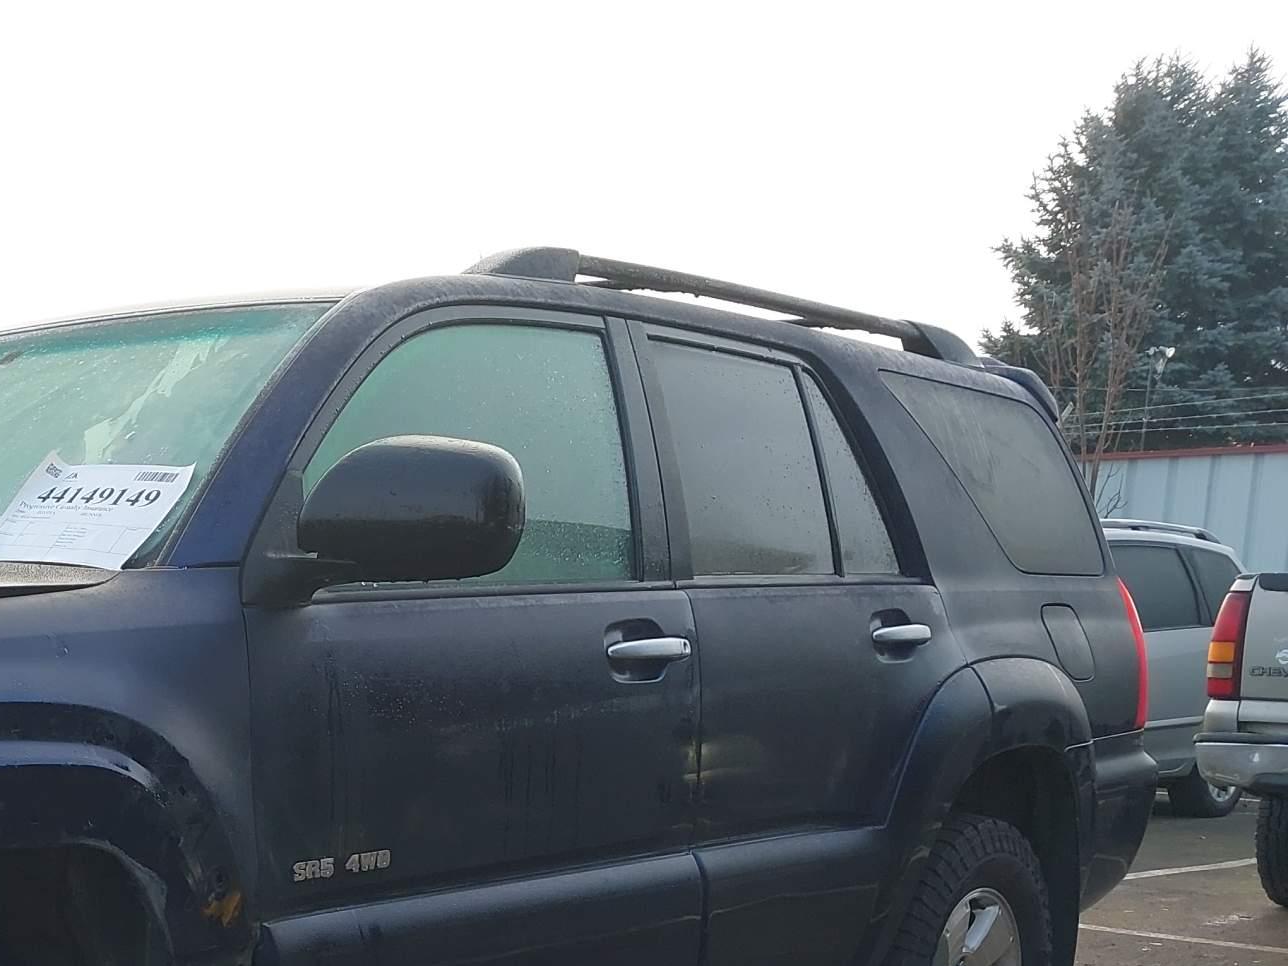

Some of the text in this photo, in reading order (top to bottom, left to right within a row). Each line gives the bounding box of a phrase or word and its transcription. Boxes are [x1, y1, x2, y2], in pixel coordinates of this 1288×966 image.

[37, 486, 162, 508] 44149149
[293, 849, 391, 881] SR5 4WD
